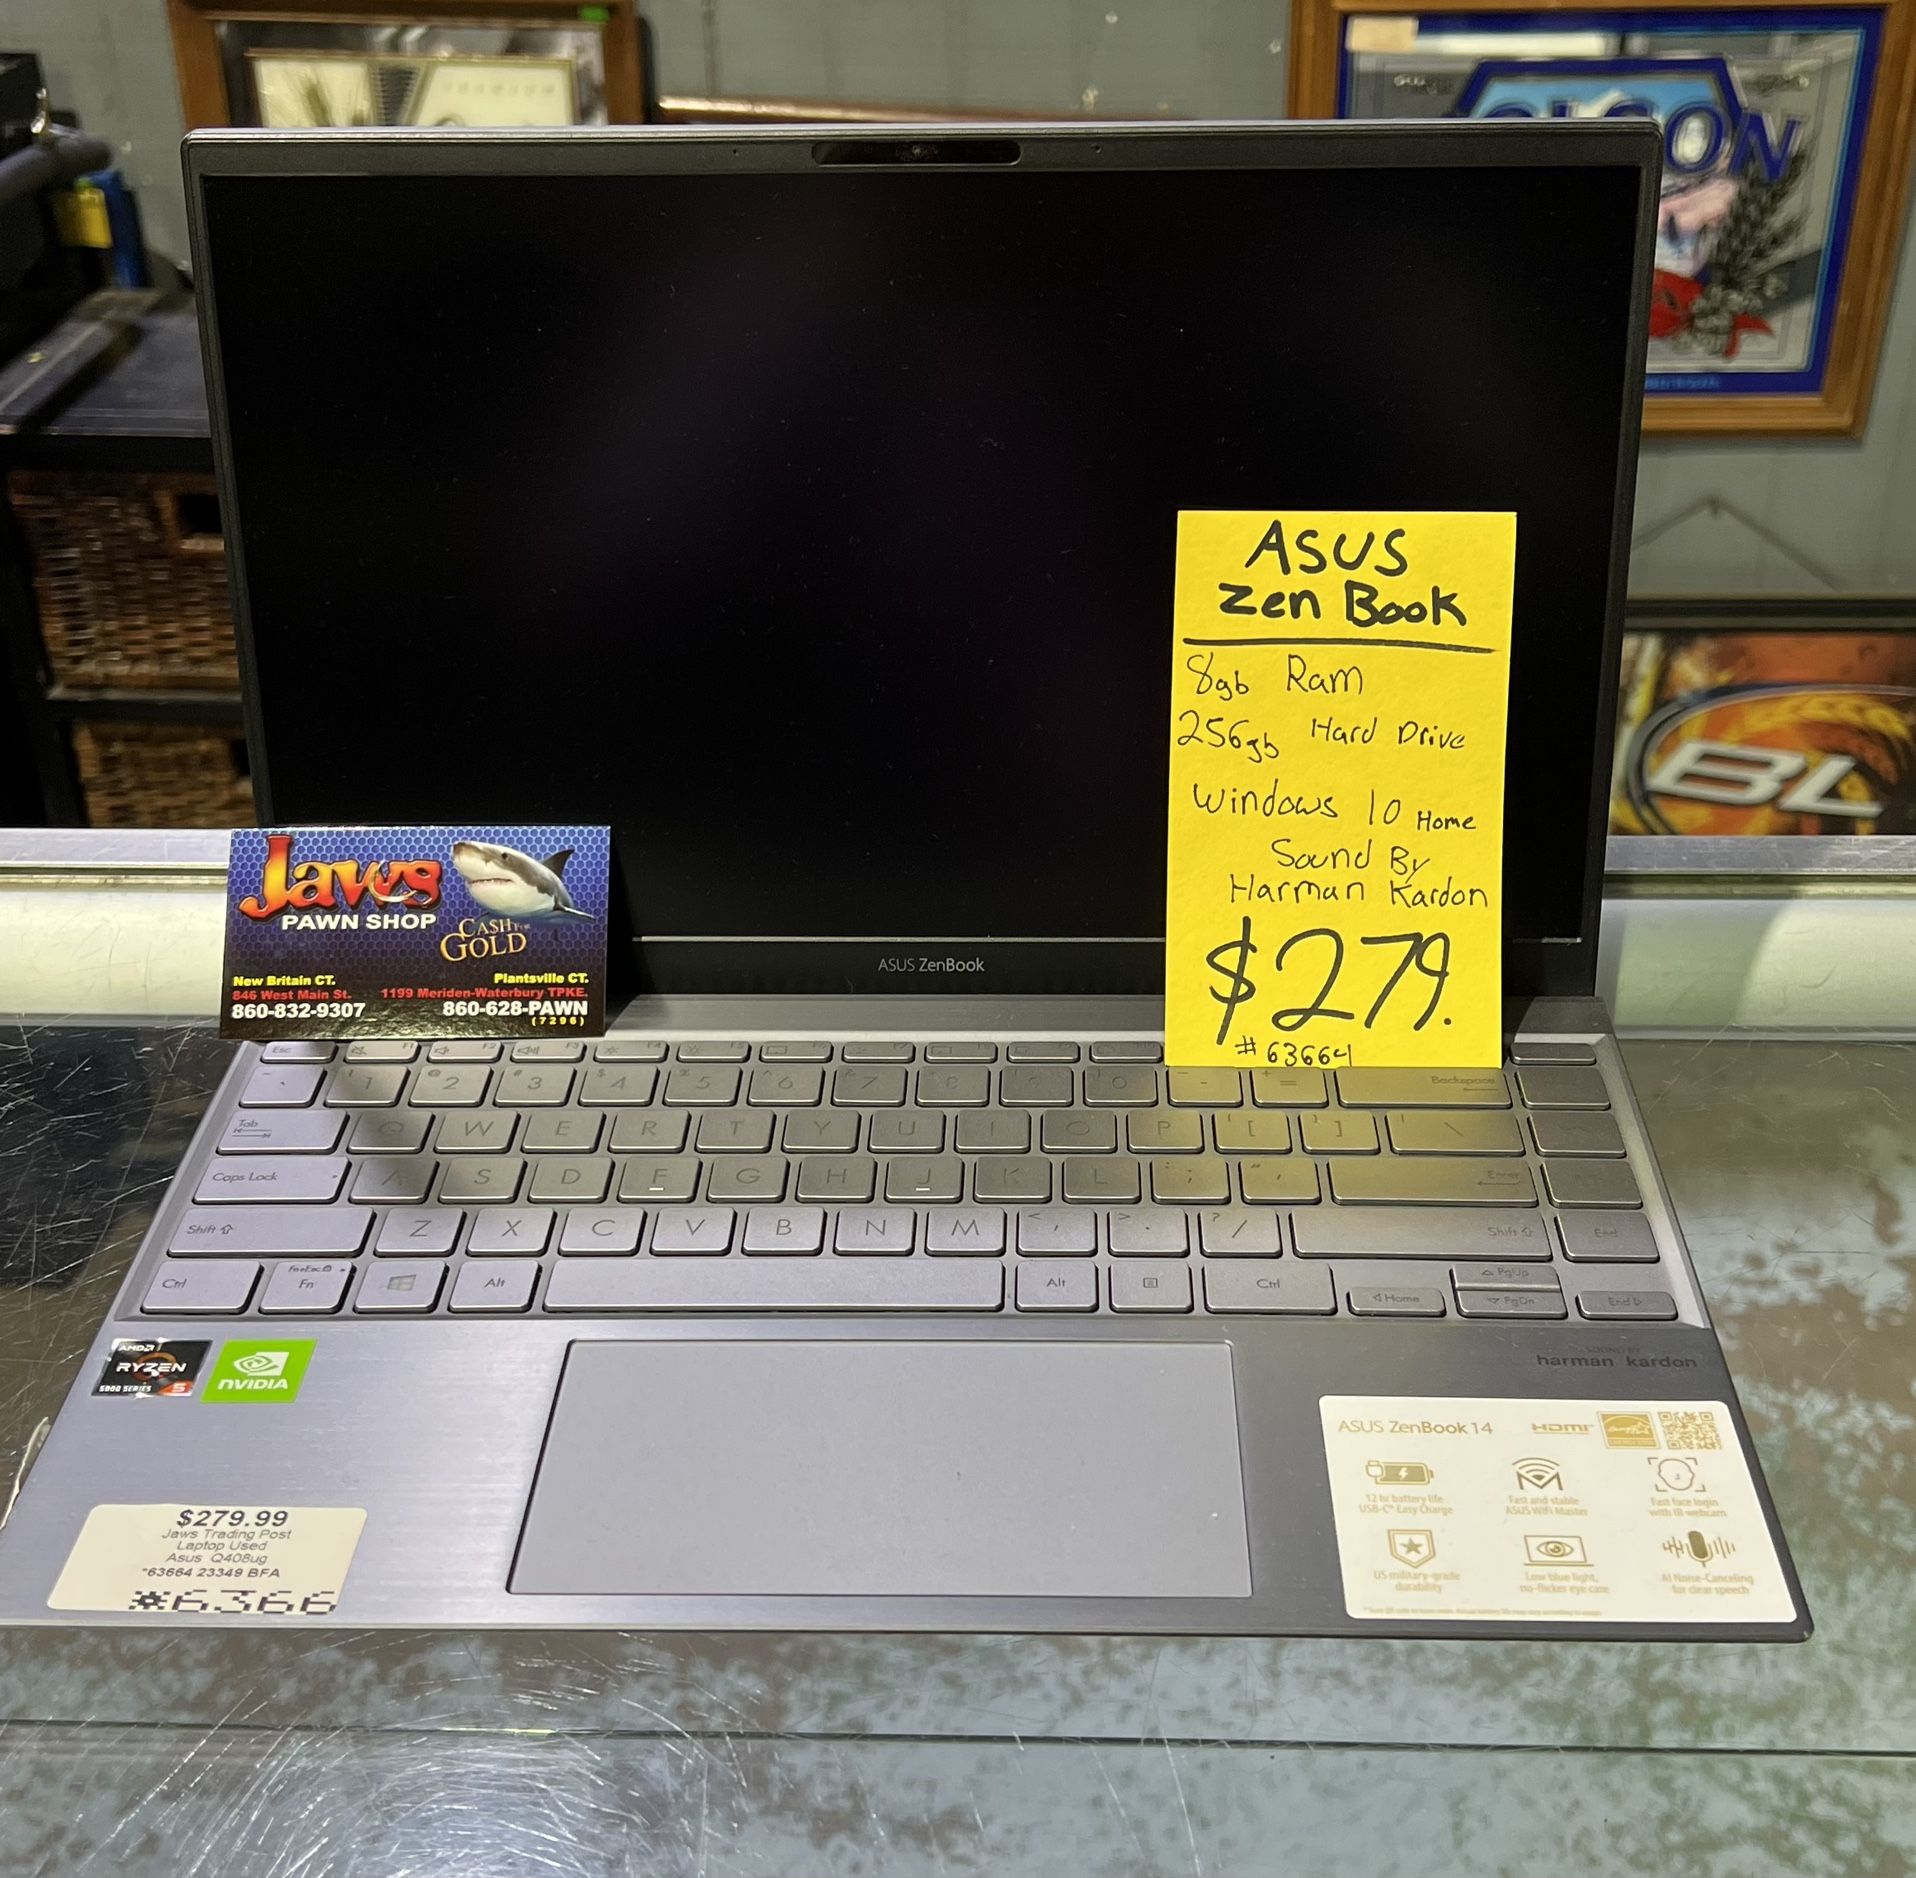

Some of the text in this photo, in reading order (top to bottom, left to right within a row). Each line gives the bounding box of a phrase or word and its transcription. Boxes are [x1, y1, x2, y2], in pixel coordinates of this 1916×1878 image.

[1245, 520, 1408, 576] ASUS
[1219, 580, 1467, 627] Zen Book
[1187, 652, 1363, 700] 8gb Ram
[1177, 710, 1466, 763] 256gb Hard Drive
[1193, 779, 1476, 831] Windows 10 Home
[1271, 839, 1430, 882] Sound By
[239, 834, 443, 919] Jaws
[1230, 874, 1488, 908] Harman Kardon
[281, 913, 437, 930] PAWN SHOP
[459, 918, 512, 938] CASH
[440, 932, 527, 962] GOLD
[878, 957, 985, 972] ASUS ZenBook
[233, 975, 336, 987] New Britain CT.
[494, 972, 589, 985] Plantsville CT.
[232, 989, 352, 1000] 846 West Main St.
[381, 987, 588, 1000] 1199 Meriden-Waterbury TPKE.
[231, 1003, 366, 1019] 860-832-9307
[442, 1000, 588, 1017] 860-628-PAWN
[272, 1046, 292, 1054] Esc
[443, 1077, 460, 1090] 2
[528, 1077, 542, 1090] 3
[697, 1077, 711, 1089] 5
[778, 1076, 793, 1089] 6
[861, 1077, 877, 1089] 7
[238, 1120, 259, 1128] Tab
[464, 1121, 494, 1137] W
[556, 1121, 573, 1136] E
[641, 1121, 657, 1136] R
[730, 1121, 745, 1136] T
[814, 1121, 831, 1136] Y
[898, 1121, 915, 1136] U
[1158, 1121, 1170, 1135] P
[212, 1171, 278, 1183] Caps Lock
[473, 1169, 491, 1185] S
[561, 1169, 582, 1185] D
[652, 1168, 668, 1185] F
[735, 1168, 761, 1184] G
[827, 1168, 847, 1184] H
[916, 1168, 931, 1184] J
[1094, 1168, 1108, 1184] L
[187, 1225, 216, 1235] Shift
[409, 1220, 431, 1237] Z
[501, 1220, 522, 1237] X
[591, 1219, 615, 1236] C
[685, 1219, 706, 1236] V
[775, 1219, 792, 1236] B
[865, 1219, 886, 1236] N
[951, 1219, 980, 1236] M
[162, 1278, 187, 1289] Ctrl
[299, 1279, 314, 1289] Fn
[484, 1278, 505, 1288] Alt
[1046, 1278, 1066, 1288] Alt
[1256, 1278, 1281, 1289] Ctrl
[1385, 1294, 1420, 1303] Home
[116, 1362, 187, 1373] RYZEN
[1536, 1354, 1697, 1368] harman kardon
[172, 1383, 187, 1392] 5
[1338, 1420, 1493, 1435] ASUS ZenBook 14
[1531, 1423, 1590, 1435] HDMI
[177, 1510, 288, 1529] $279.99
[161, 1529, 292, 1542] Jaws Trading Post
[177, 1540, 267, 1552] Laptop Used
[165, 1553, 268, 1565] Asus Q408ug
[197, 1567, 244, 1578] 23349
[247, 1567, 280, 1578] BFA
